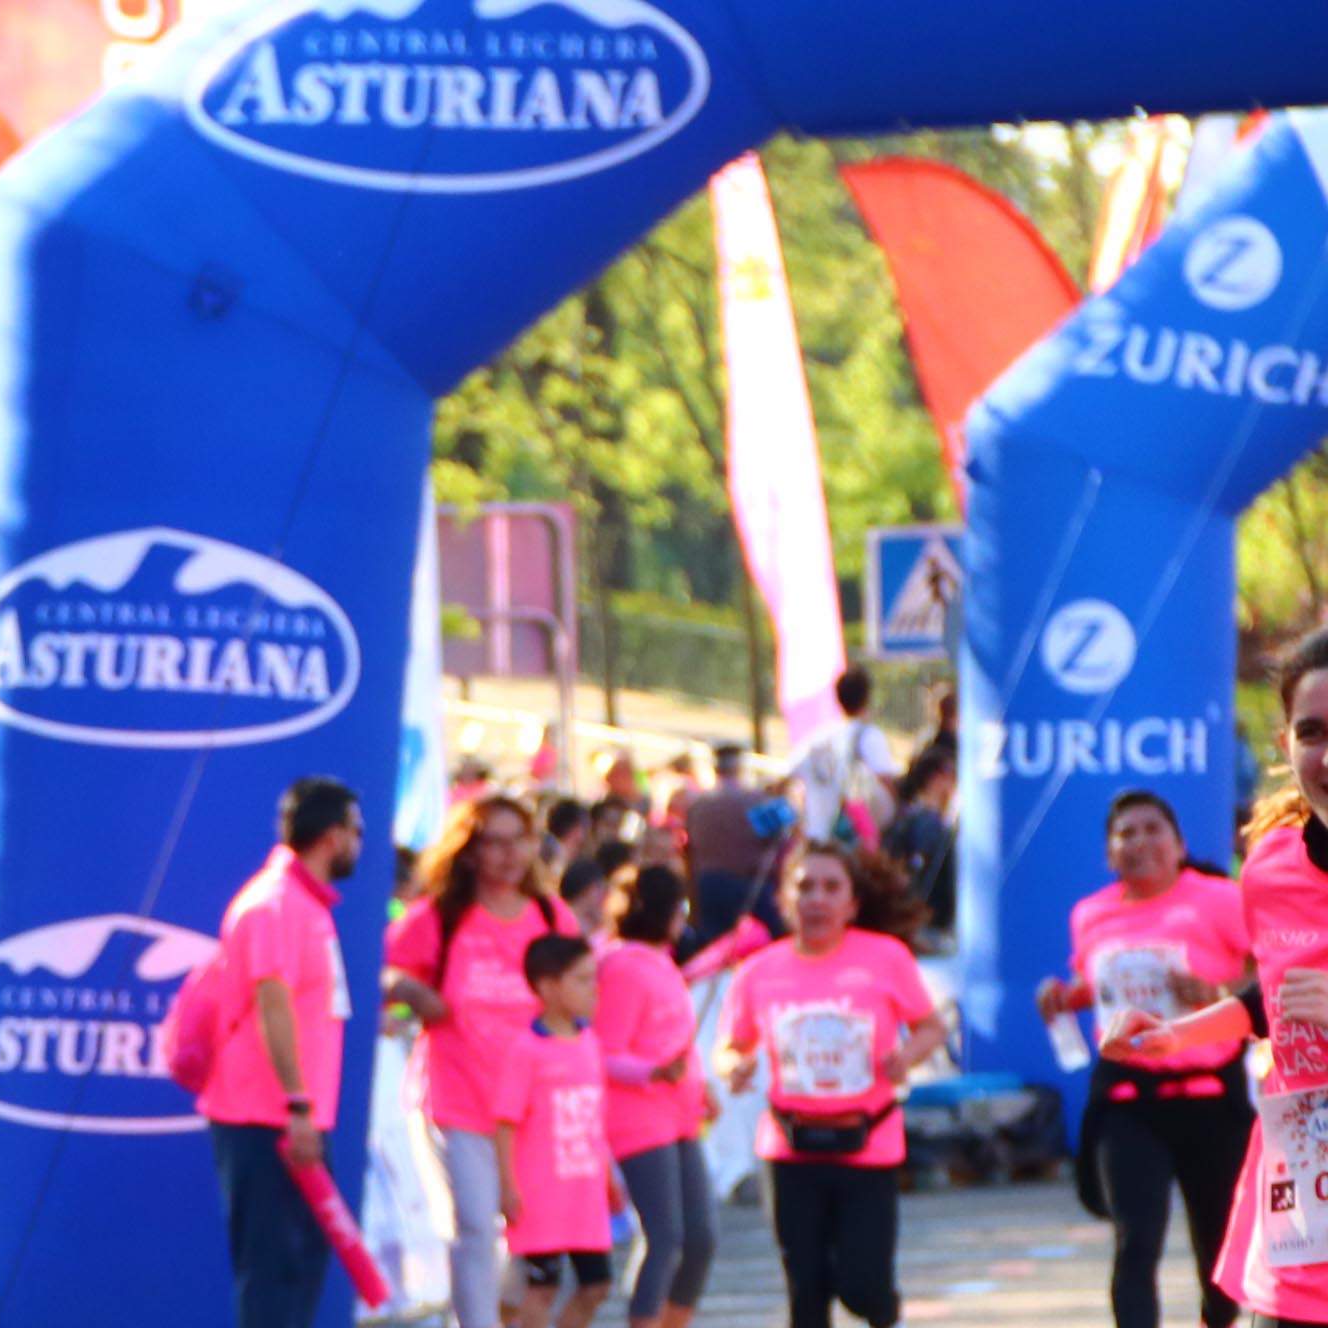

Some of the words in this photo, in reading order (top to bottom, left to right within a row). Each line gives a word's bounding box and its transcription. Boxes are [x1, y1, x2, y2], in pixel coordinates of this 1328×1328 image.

[302, 28, 469, 57] CENTRAL
[221, 43, 667, 131] ASTURIANA
[1073, 322, 1328, 407] ZURICH
[975, 716, 1208, 781] ZURICH
